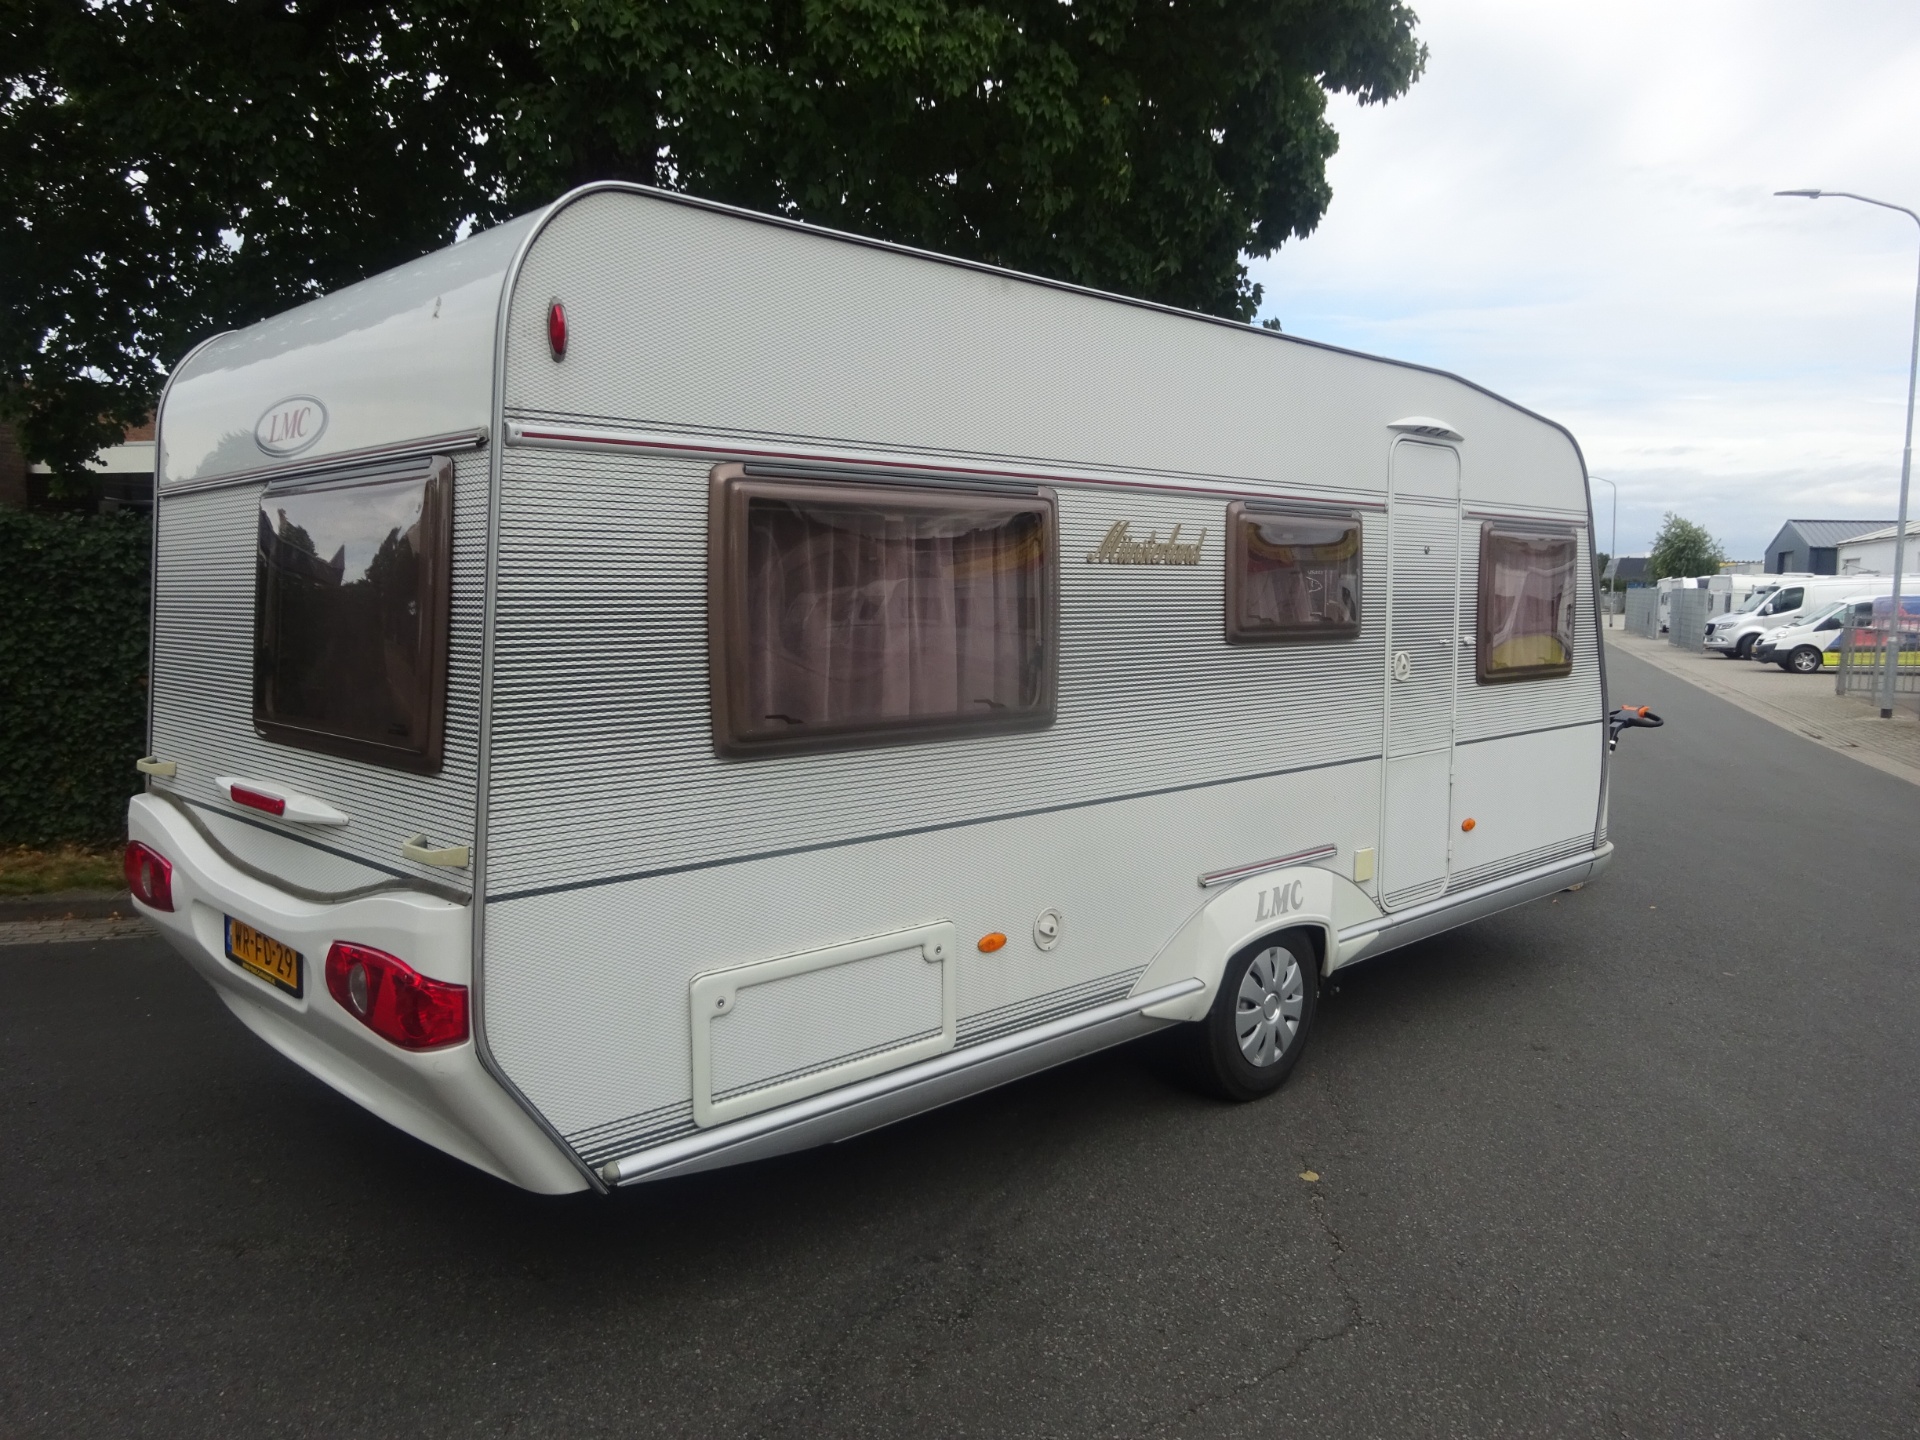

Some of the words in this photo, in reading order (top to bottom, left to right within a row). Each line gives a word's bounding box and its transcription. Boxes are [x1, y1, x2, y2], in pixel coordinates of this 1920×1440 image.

[267, 406, 311, 443] LMC
[1254, 879, 1304, 922] LMC
[234, 920, 293, 979] WR-FD-29
